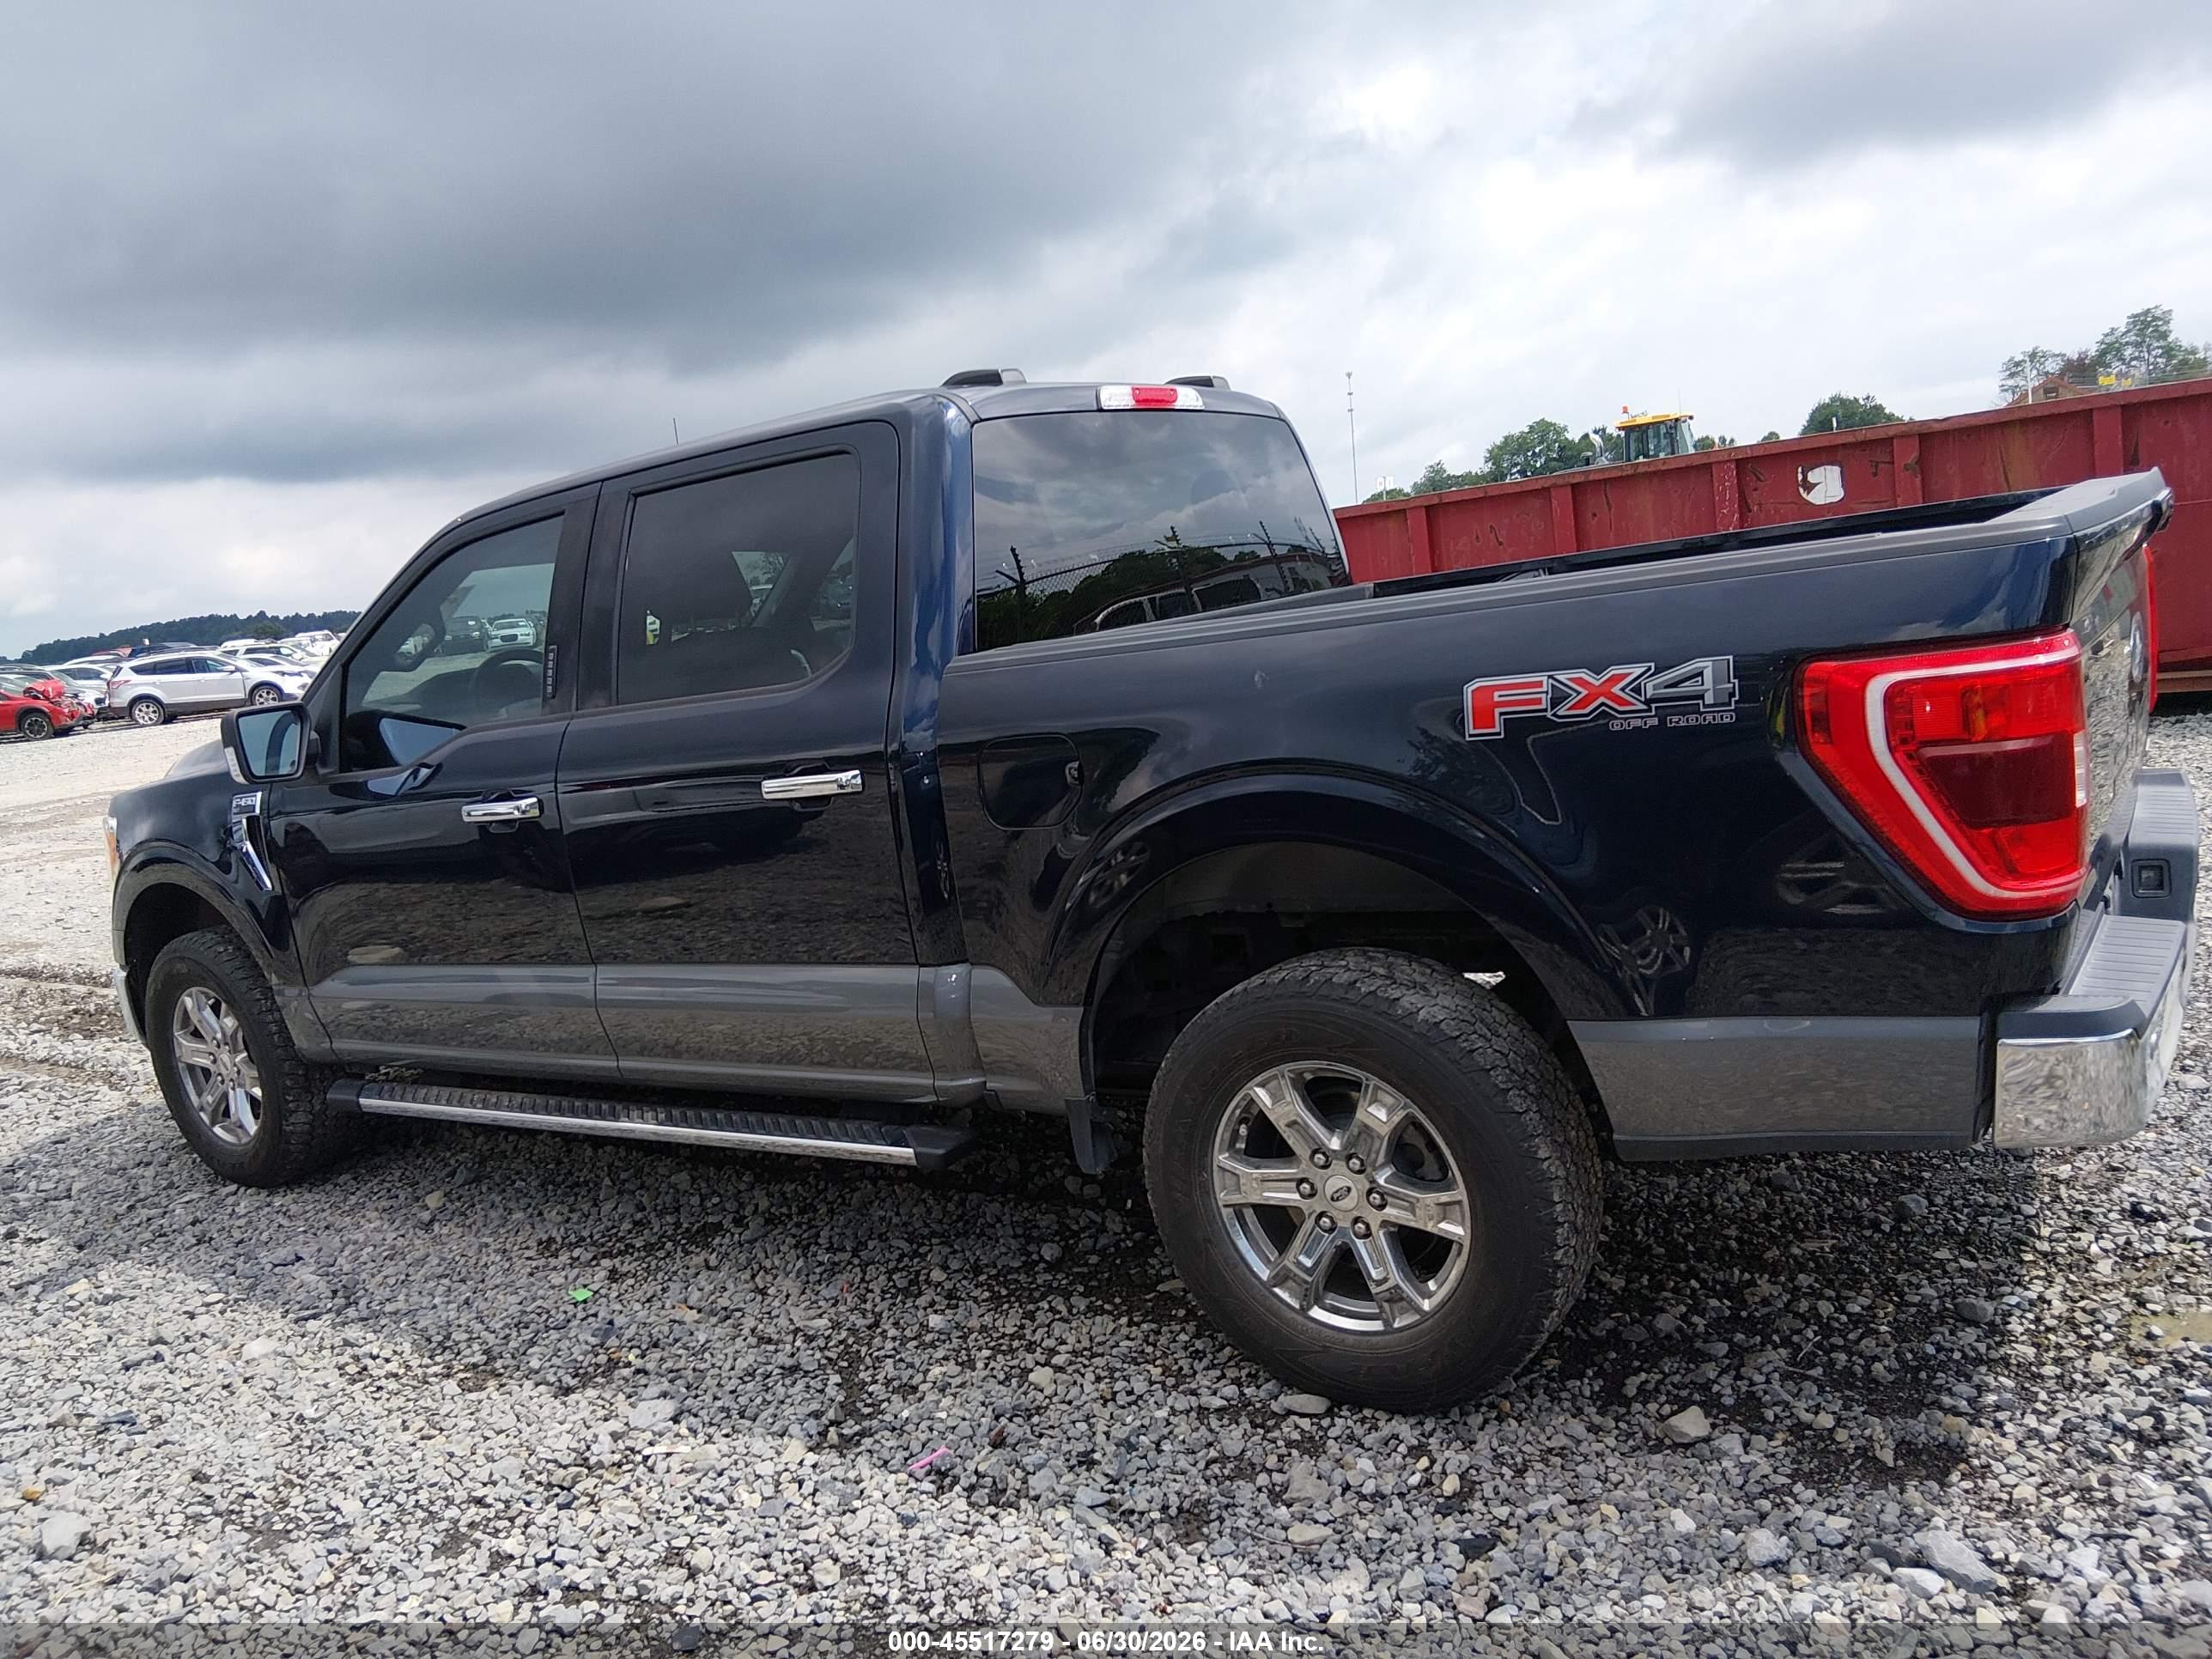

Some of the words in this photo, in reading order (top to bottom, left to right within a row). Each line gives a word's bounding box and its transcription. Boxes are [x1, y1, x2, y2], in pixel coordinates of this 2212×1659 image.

[1463, 655, 1739, 740] FX4
[1609, 717, 1658, 731] OFF
[1667, 712, 1735, 727] ROAD
